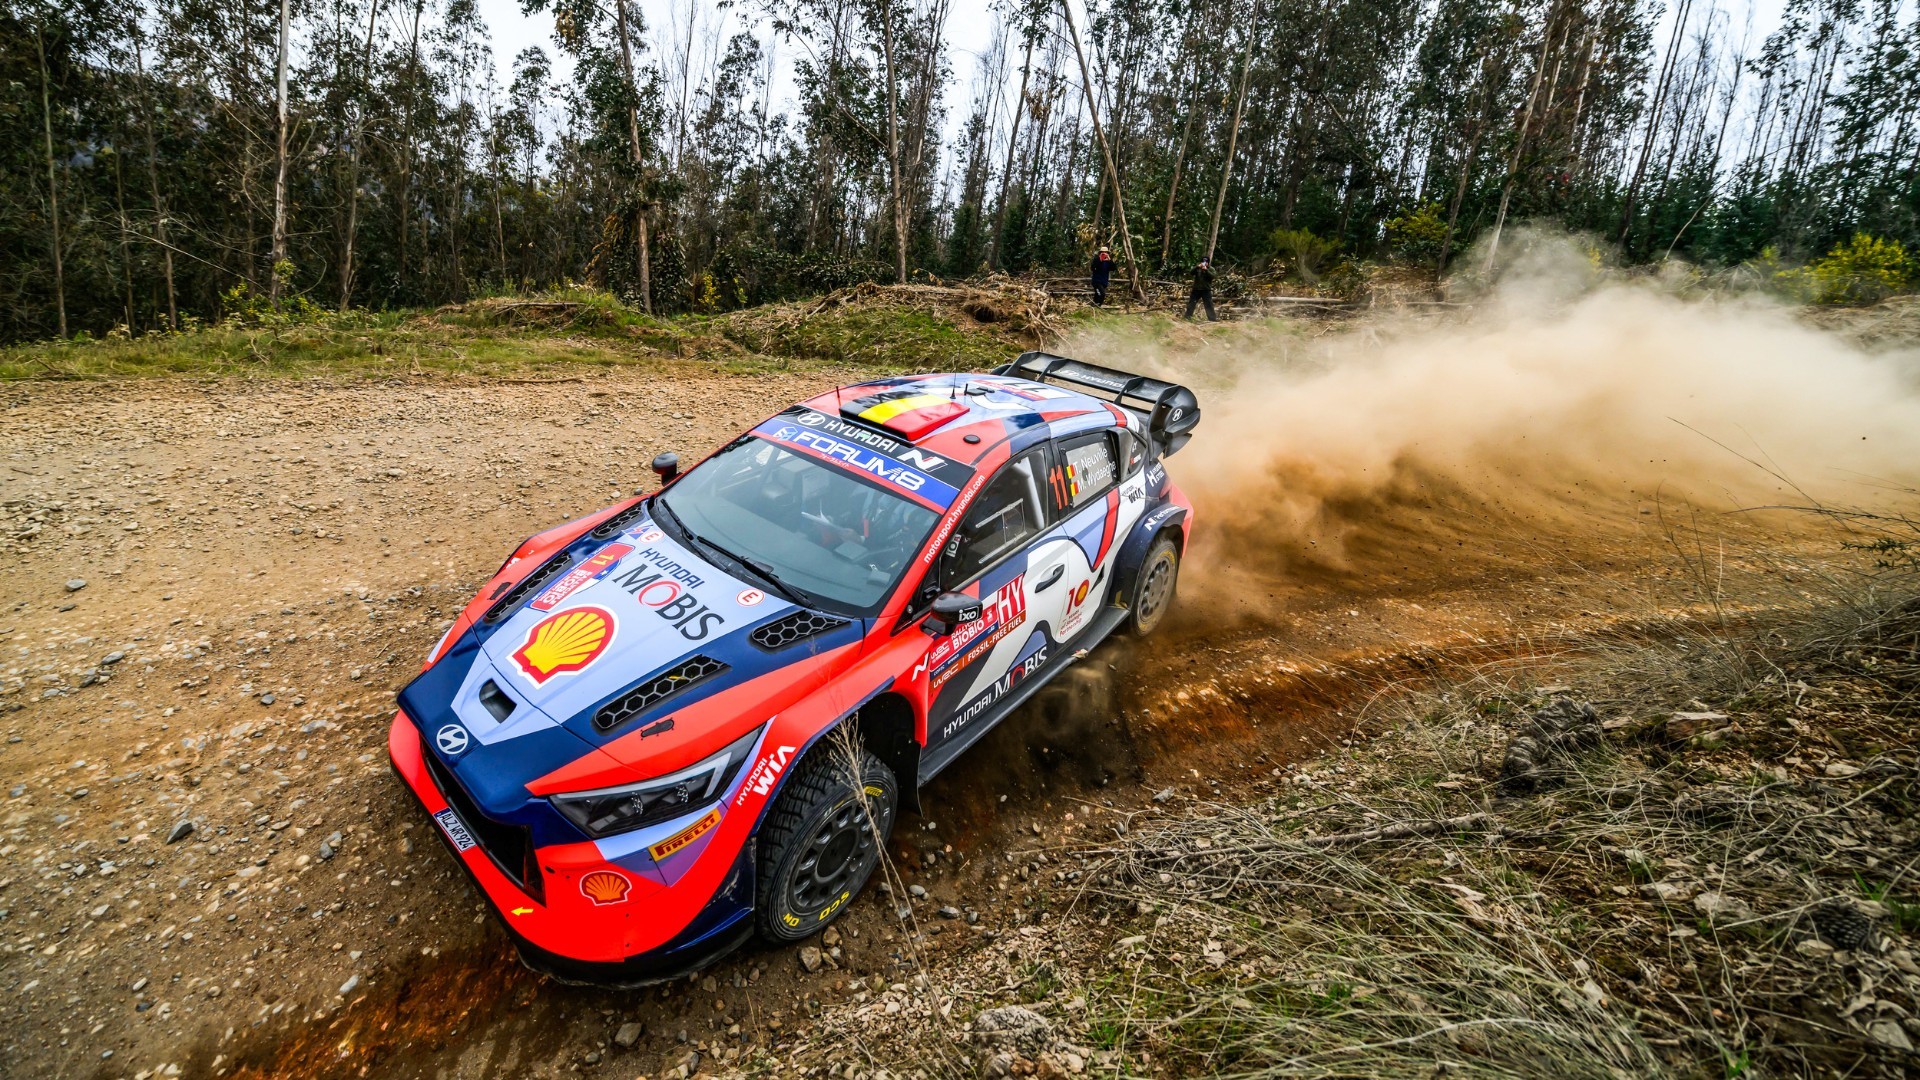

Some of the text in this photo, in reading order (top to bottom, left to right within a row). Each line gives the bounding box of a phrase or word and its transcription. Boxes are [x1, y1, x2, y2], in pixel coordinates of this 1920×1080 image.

[793, 431, 926, 491] FORUM8
[1081, 446, 1108, 470] Neuville
[1086, 460, 1117, 487] Wydaeghe
[1049, 464, 1069, 510] 11
[923, 474, 986, 564] motorsport.hyundai.com
[590, 551, 616, 567] 11
[639, 547, 706, 590] HYUNDAI
[612, 563, 726, 642] MOBIS
[742, 591, 759, 603] E
[958, 609, 977, 622] ixo
[999, 576, 1023, 625] HY
[1008, 616, 1023, 632] FUEL
[943, 646, 1048, 739] HYUNDAI MOBIS
[736, 757, 768, 806] HYUNDAI
[654, 812, 716, 857] PIRELLI
